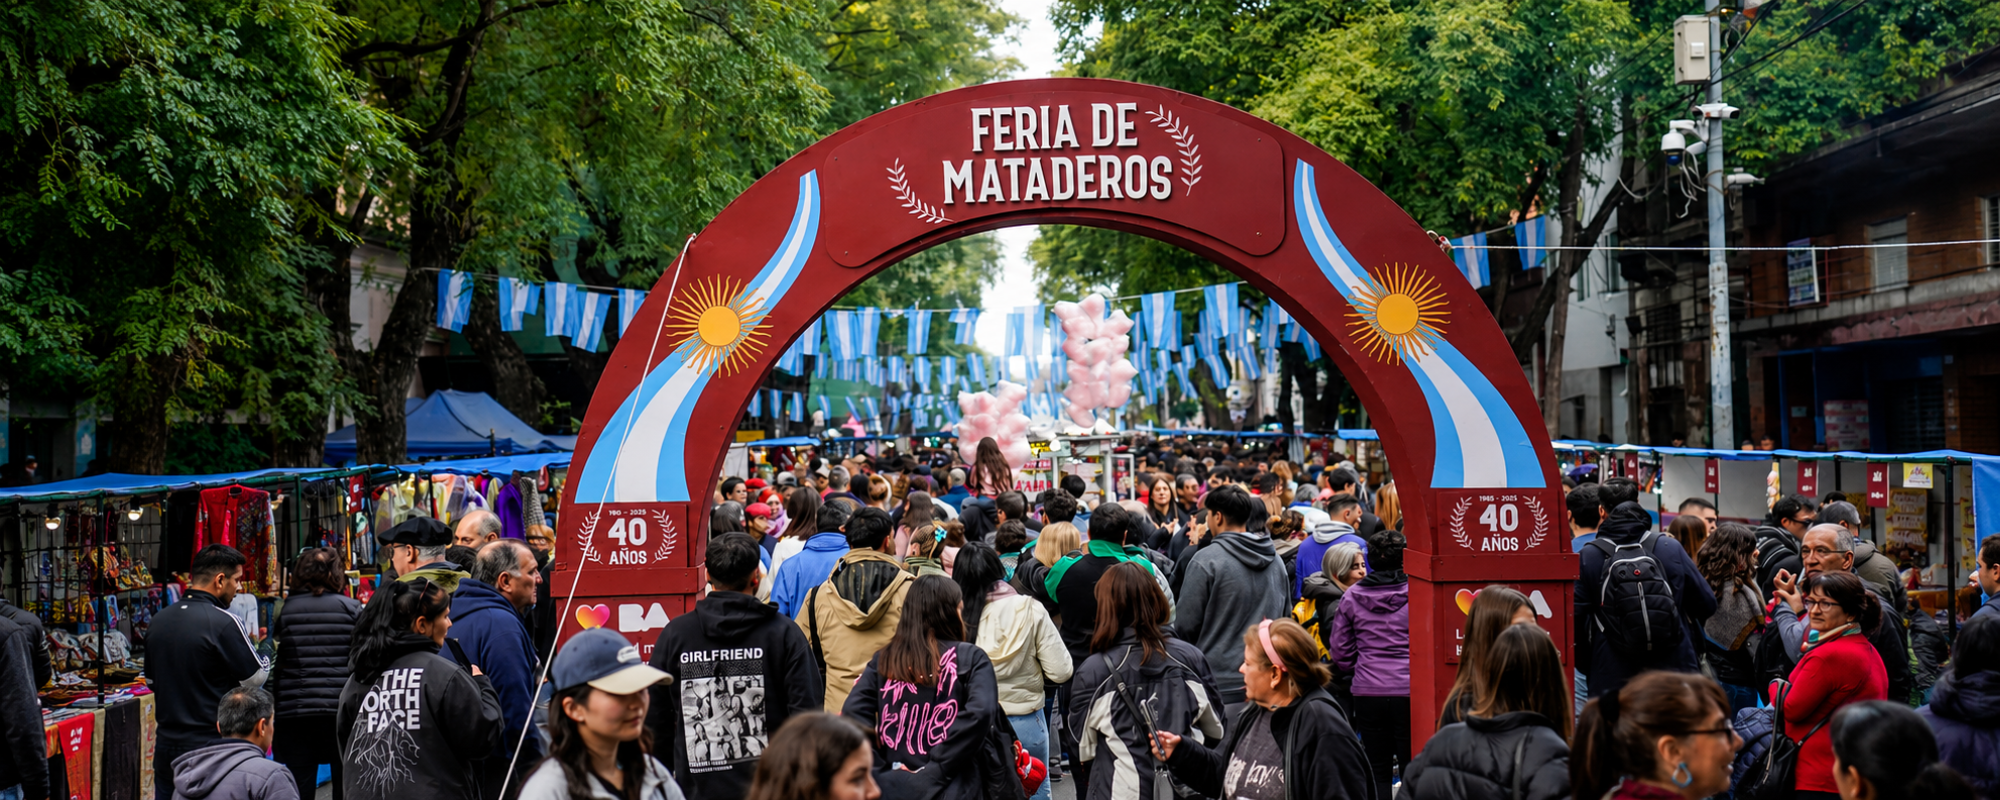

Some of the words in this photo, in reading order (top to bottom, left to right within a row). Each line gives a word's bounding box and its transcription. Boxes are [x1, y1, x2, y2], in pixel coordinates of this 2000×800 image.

[970, 104, 1080, 152] FERIA
[1091, 102, 1138, 147] DE
[942, 155, 1173, 204] MATADEROS
[1479, 503, 1519, 532] 40
[607, 517, 647, 546] 40
[1481, 533, 1519, 551] AÑOS
[608, 547, 647, 565] AÑOS
[618, 602, 670, 632] BA
[680, 647, 763, 663] GIRLFRIEND
[381, 668, 424, 690] THE
[359, 688, 420, 712] ORTH
